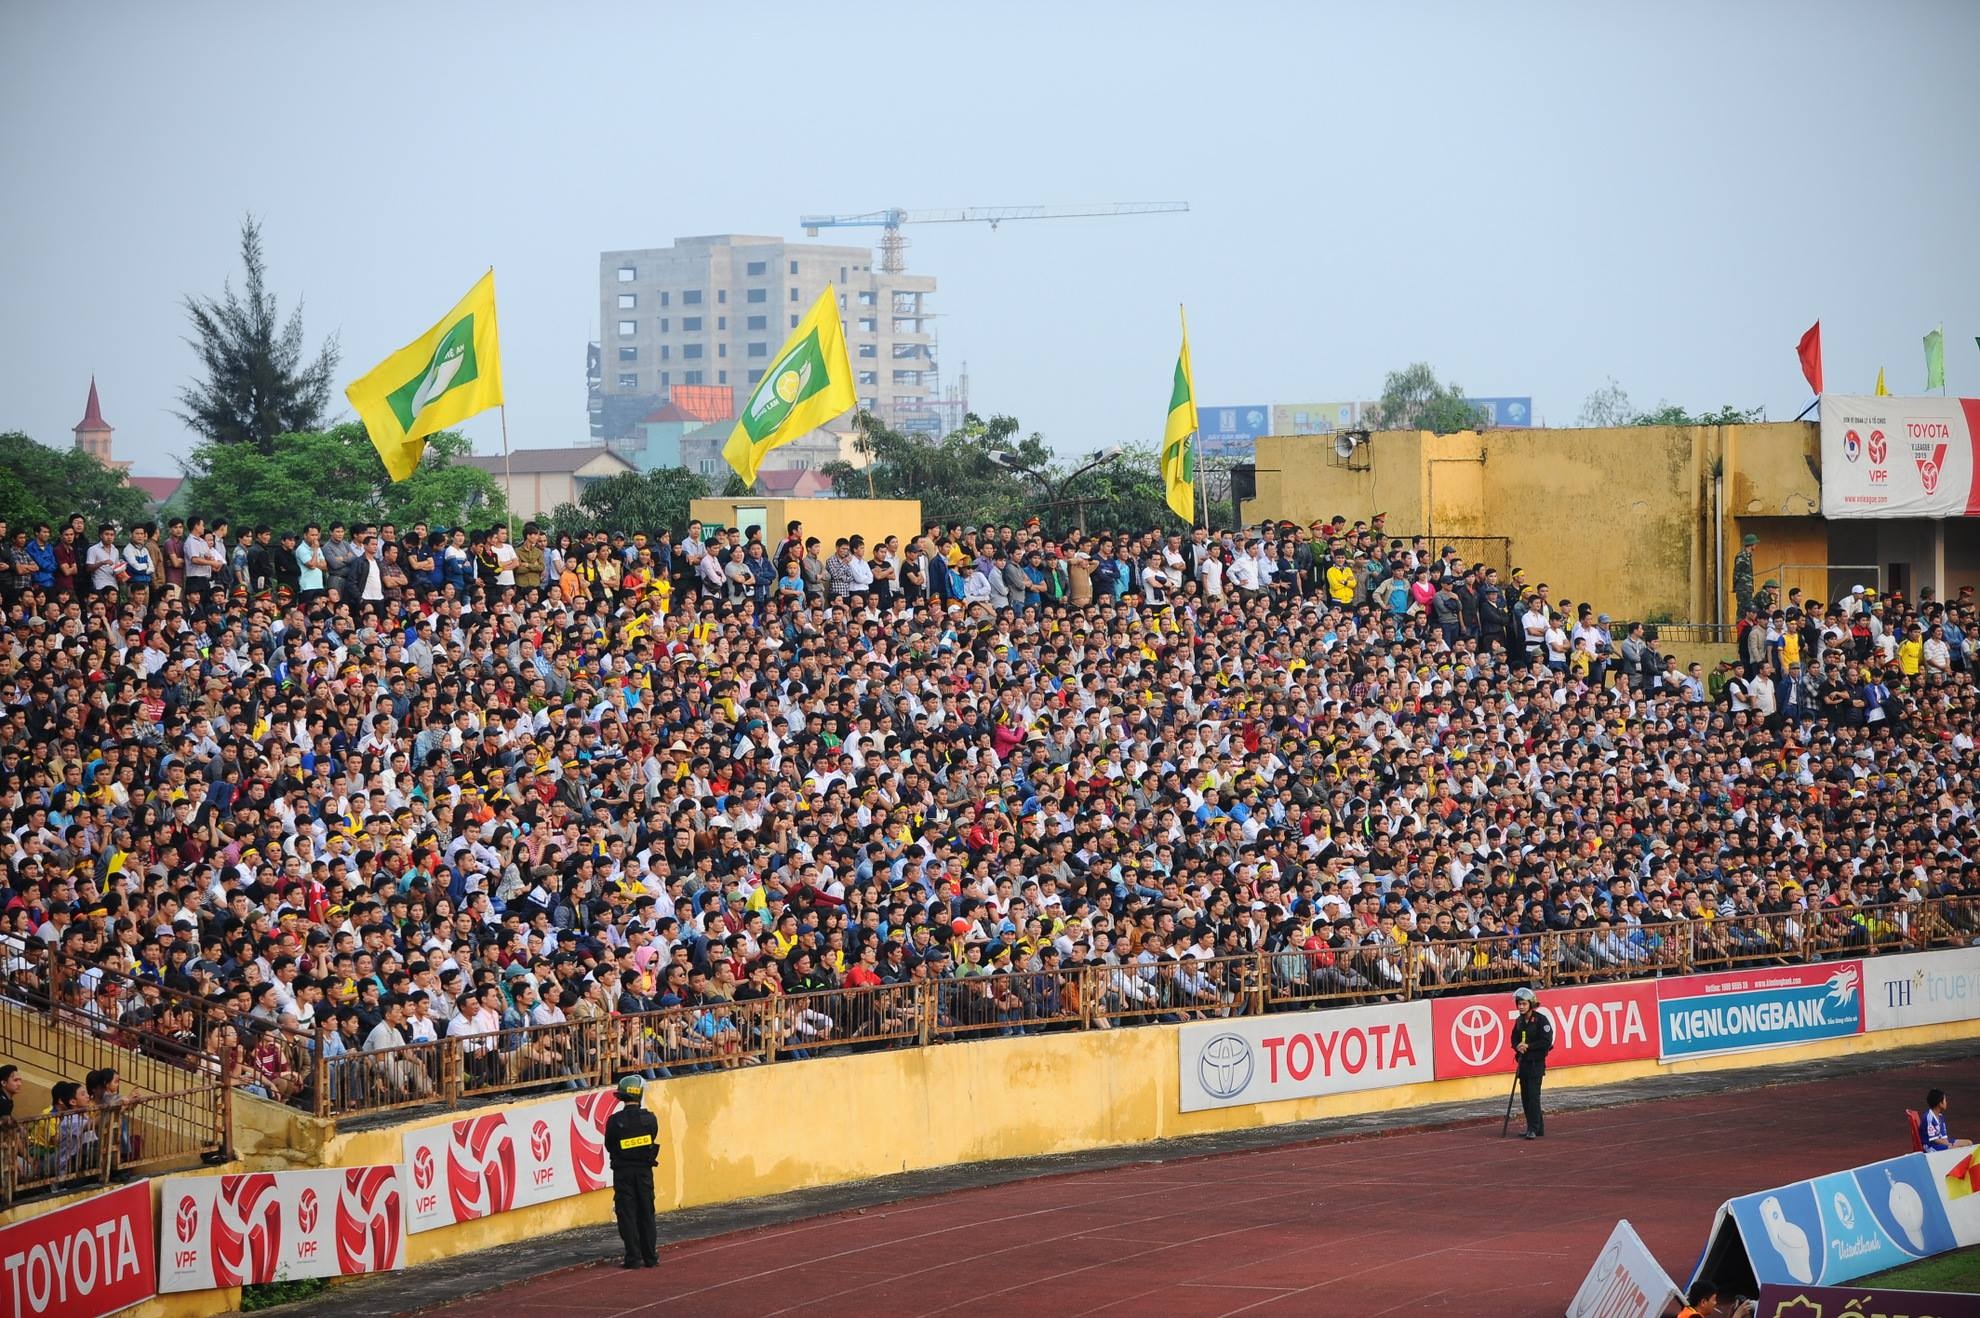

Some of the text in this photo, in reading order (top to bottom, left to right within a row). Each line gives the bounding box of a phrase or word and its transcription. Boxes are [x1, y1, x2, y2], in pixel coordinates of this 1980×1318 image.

[1907, 424, 1949, 438] TOYOTA
[1869, 470, 1887, 482] VPF
[1884, 979, 1912, 1008] TH
[1262, 1023, 1416, 1083] TOYOTA
[533, 1167, 553, 1185] VPF
[415, 1195, 436, 1213] VPF
[297, 1240, 317, 1259] VPF
[4, 1214, 140, 1318] TOYOTA
[175, 1251, 197, 1268] VPF
